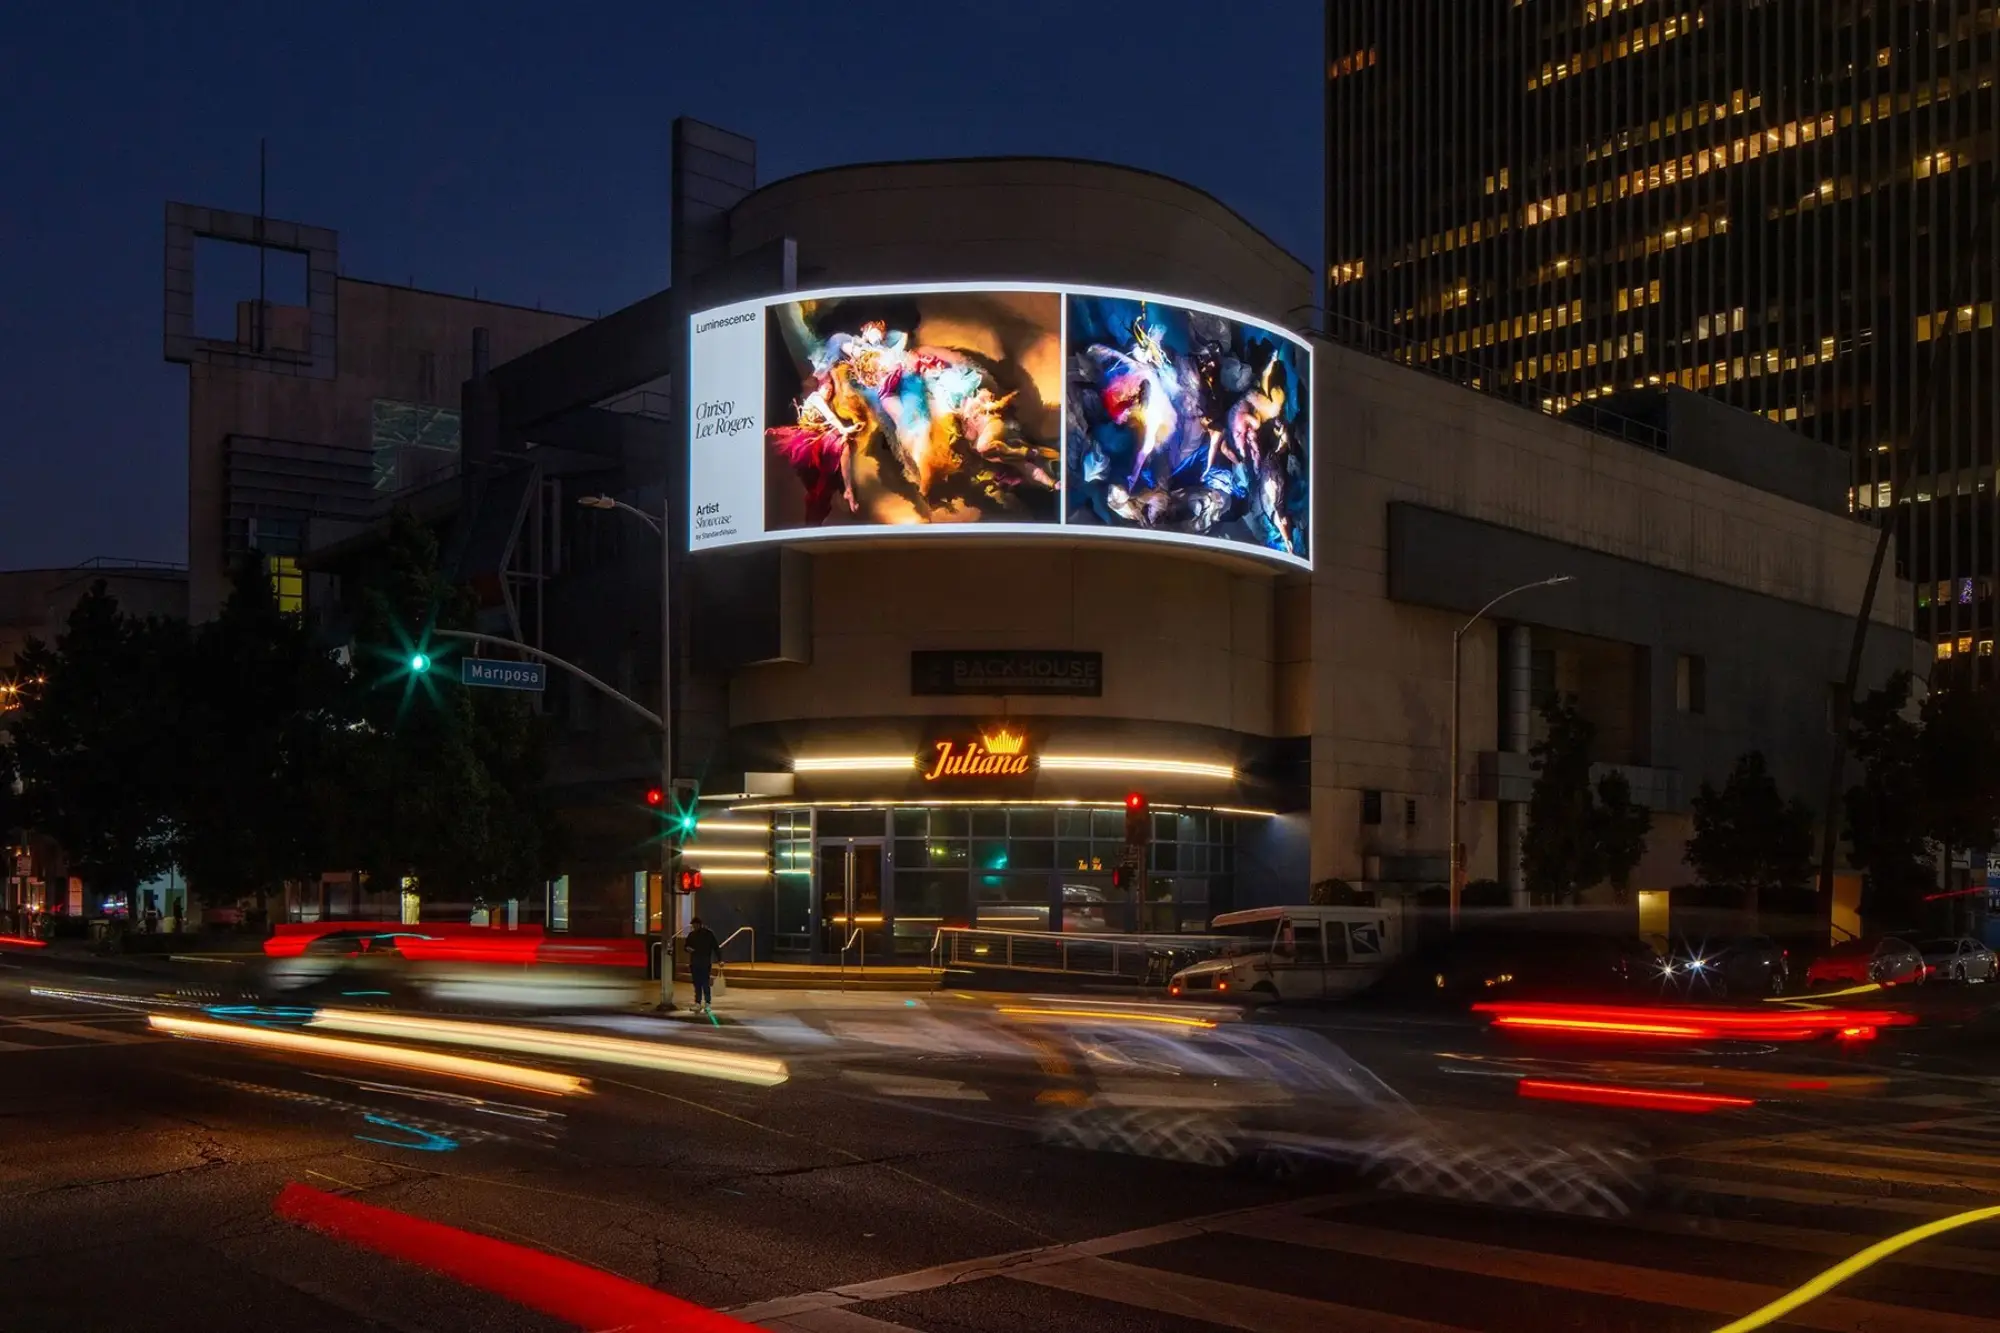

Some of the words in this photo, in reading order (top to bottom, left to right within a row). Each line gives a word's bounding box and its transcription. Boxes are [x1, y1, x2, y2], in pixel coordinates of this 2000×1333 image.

[696, 312, 756, 334] Luminescence
[696, 400, 735, 421] Christy
[696, 423, 714, 439] Lee
[716, 416, 755, 437] Rogers
[696, 502, 719, 516] Artist
[471, 664, 539, 683] Mariposa
[925, 742, 1029, 780] Juliana
